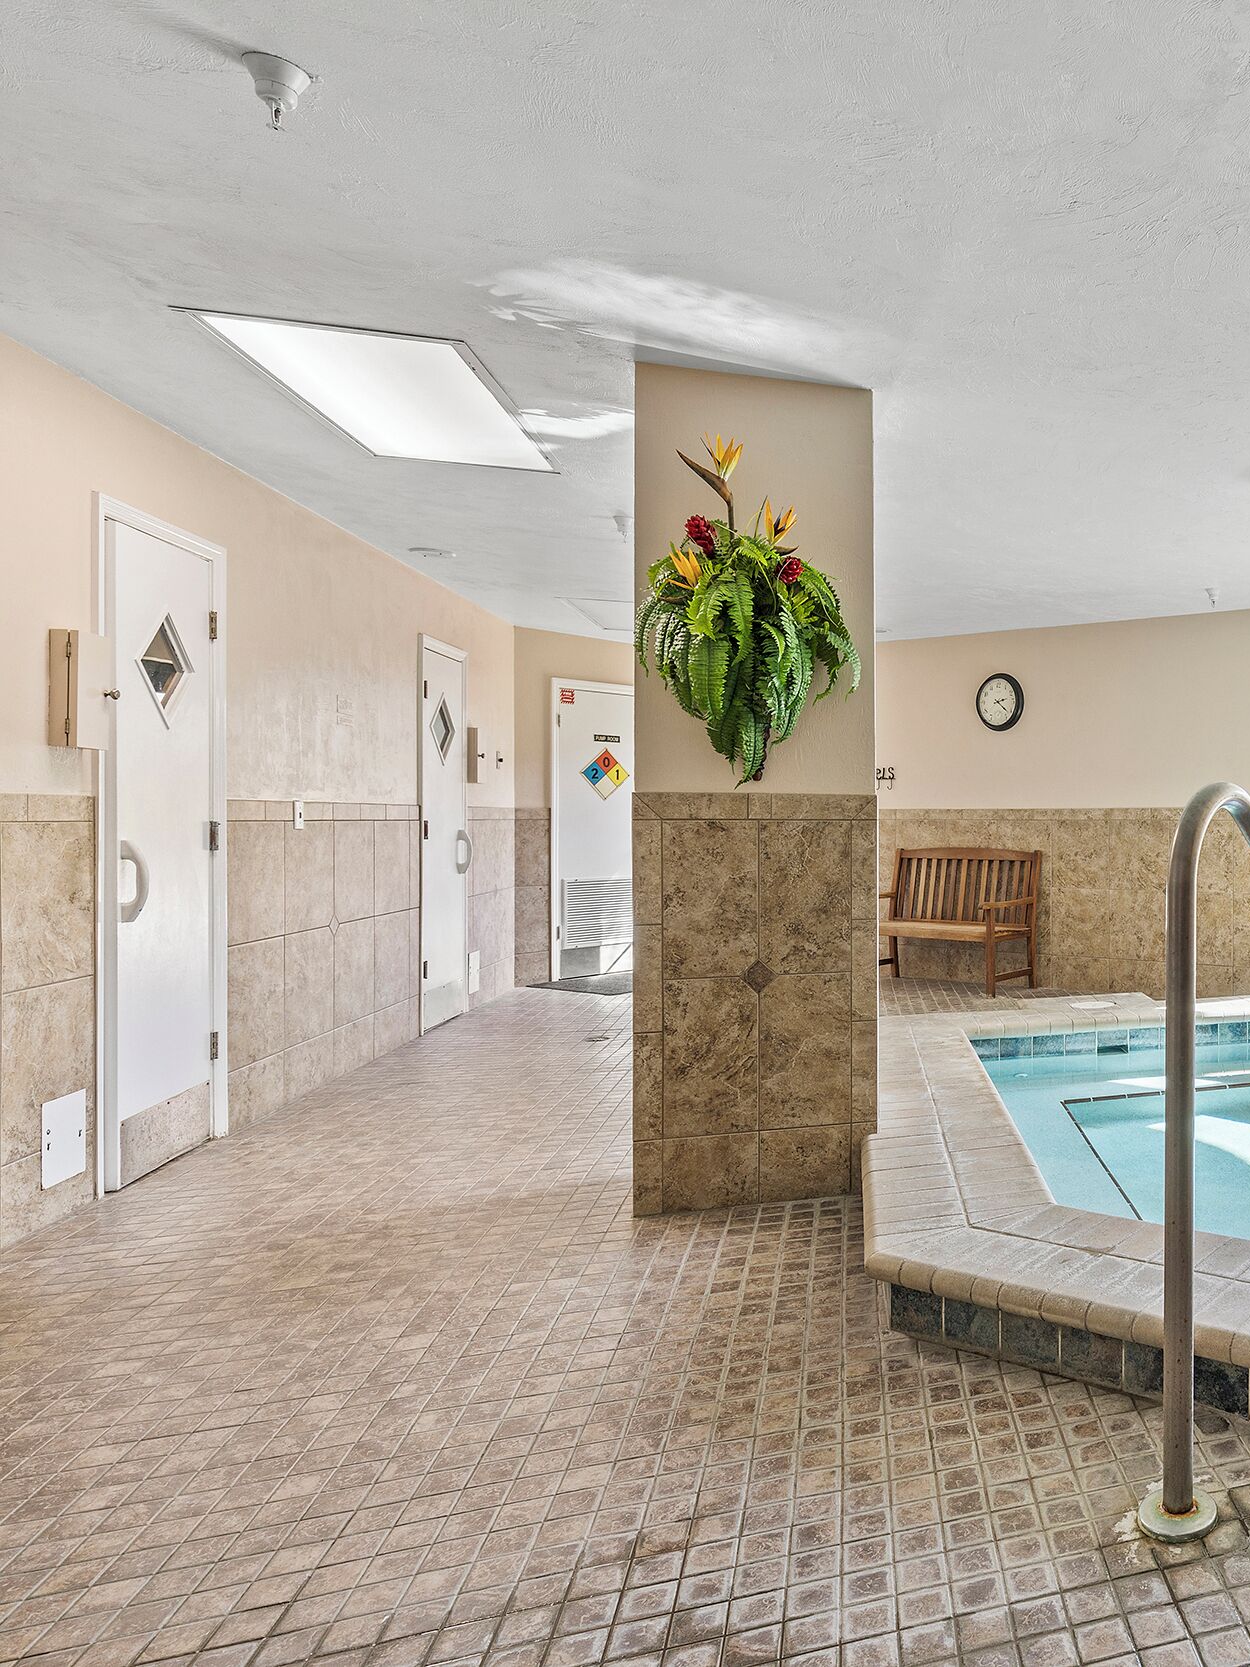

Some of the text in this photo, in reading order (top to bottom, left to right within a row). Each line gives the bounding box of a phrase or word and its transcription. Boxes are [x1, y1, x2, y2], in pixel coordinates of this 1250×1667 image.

[603, 757, 610, 768] 0
[591, 768, 598, 779] 2
[616, 770, 619, 780] 1
